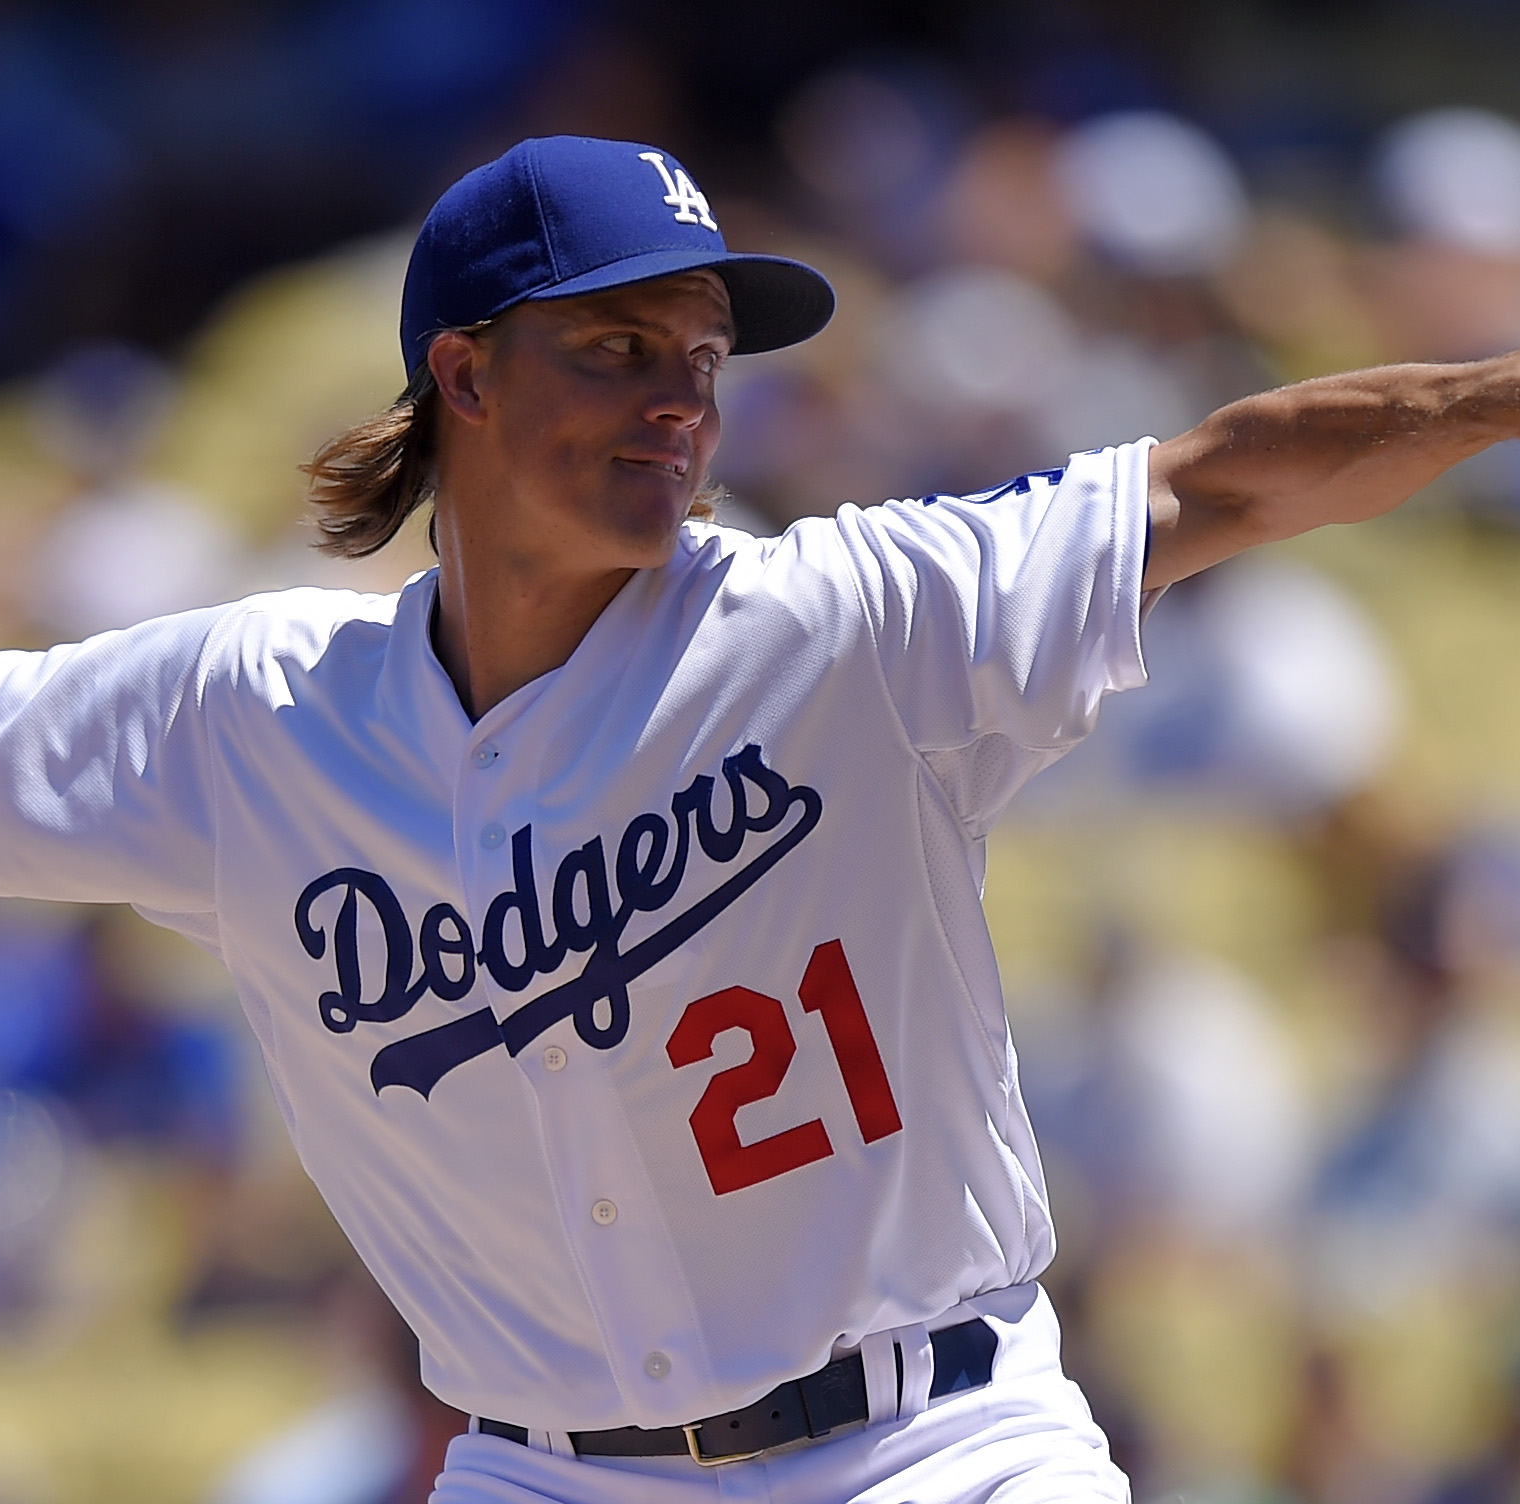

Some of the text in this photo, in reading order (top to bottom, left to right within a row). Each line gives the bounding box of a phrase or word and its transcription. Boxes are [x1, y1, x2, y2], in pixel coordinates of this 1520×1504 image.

[637, 151, 719, 233] LA
[294, 743, 823, 1060] Dodgers
[664, 937, 904, 1197] 21
